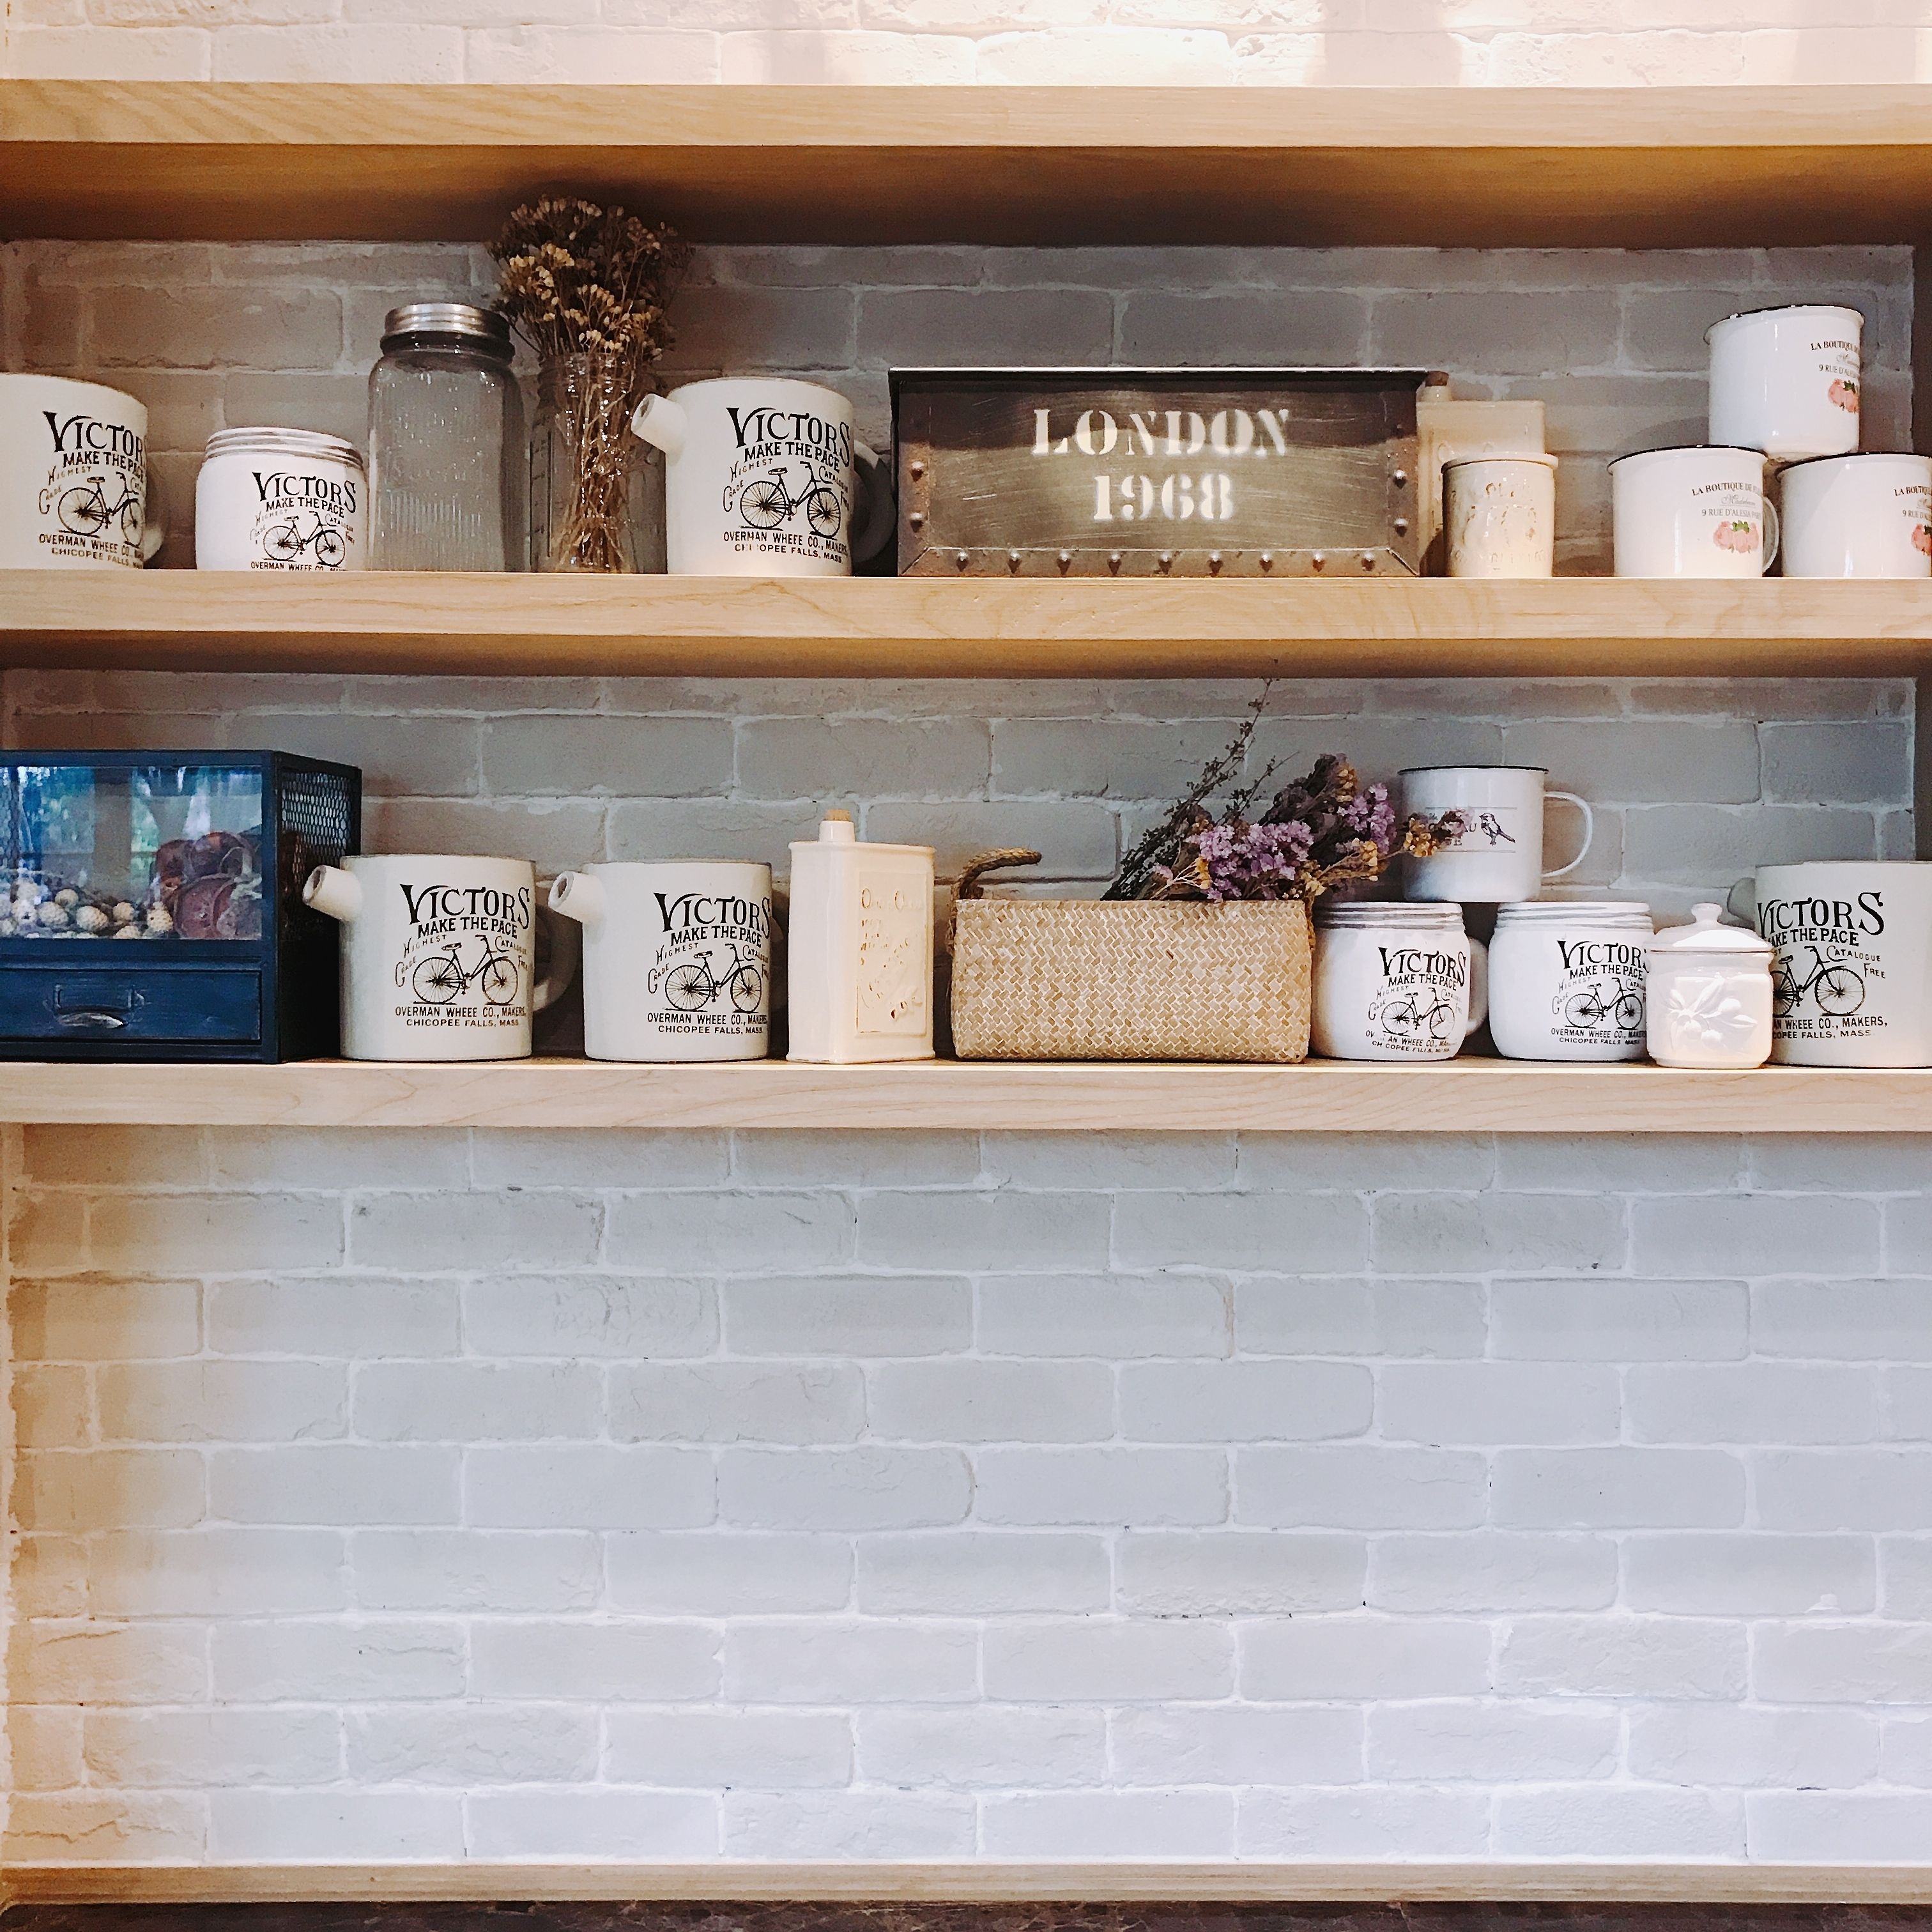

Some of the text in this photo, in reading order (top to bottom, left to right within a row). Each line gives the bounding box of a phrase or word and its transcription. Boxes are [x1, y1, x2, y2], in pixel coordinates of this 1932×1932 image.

[1825, 365, 1837, 373] RUE
[42, 411, 146, 468] VICTOR
[726, 407, 850, 467] VICTORS
[1031, 409, 1289, 457] LONDON
[63, 451, 100, 468] MAKE
[103, 452, 126, 469] THE
[744, 441, 841, 473] MAKE THE PACE
[730, 458, 772, 482] HIGHEST
[252, 472, 356, 513] VICTORS
[1692, 486, 1703, 496] LA
[1705, 482, 1744, 494] BOUTIQUE
[1093, 475, 1234, 521] 1968
[266, 497, 344, 518] MAKE THE PACE
[39, 533, 86, 547] OVERMAN
[723, 532, 767, 542] OVERMAN
[51, 548, 103, 560] CHICOPEE
[735, 544, 786, 553] CHIOPEE
[400, 884, 530, 930] VICTORS
[1758, 892, 1884, 939] VICTORS
[654, 893, 770, 939] VICTORS
[418, 917, 518, 939] MAKE THE PACE
[671, 926, 762, 947] MAKE THE PACE
[1791, 928, 1818, 942] THE
[1821, 928, 1859, 947] PACE
[404, 935, 446, 958] HIGHEST
[656, 942, 698, 965] HIGHEST
[1827, 946, 1880, 962] CATALOGUE
[1378, 947, 1466, 986] VICTORS
[1570, 965, 1643, 981] MAKE THE PACE
[1864, 963, 1886, 979] FREE
[1388, 974, 1457, 991] MAKE THE PACE
[1559, 977, 1591, 993] HIGHEST
[395, 1006, 440, 1016] OVERMAN
[648, 1013, 691, 1023] OVERMAN
[406, 1018, 460, 1027] CHICOPEE
[659, 1025, 710, 1034] CHICOPEE
[1365, 1030, 1397, 1043] OVAN
[1551, 1028, 1584, 1036] OVERMAN
[1372, 1041, 1409, 1051] CHCOPEE
